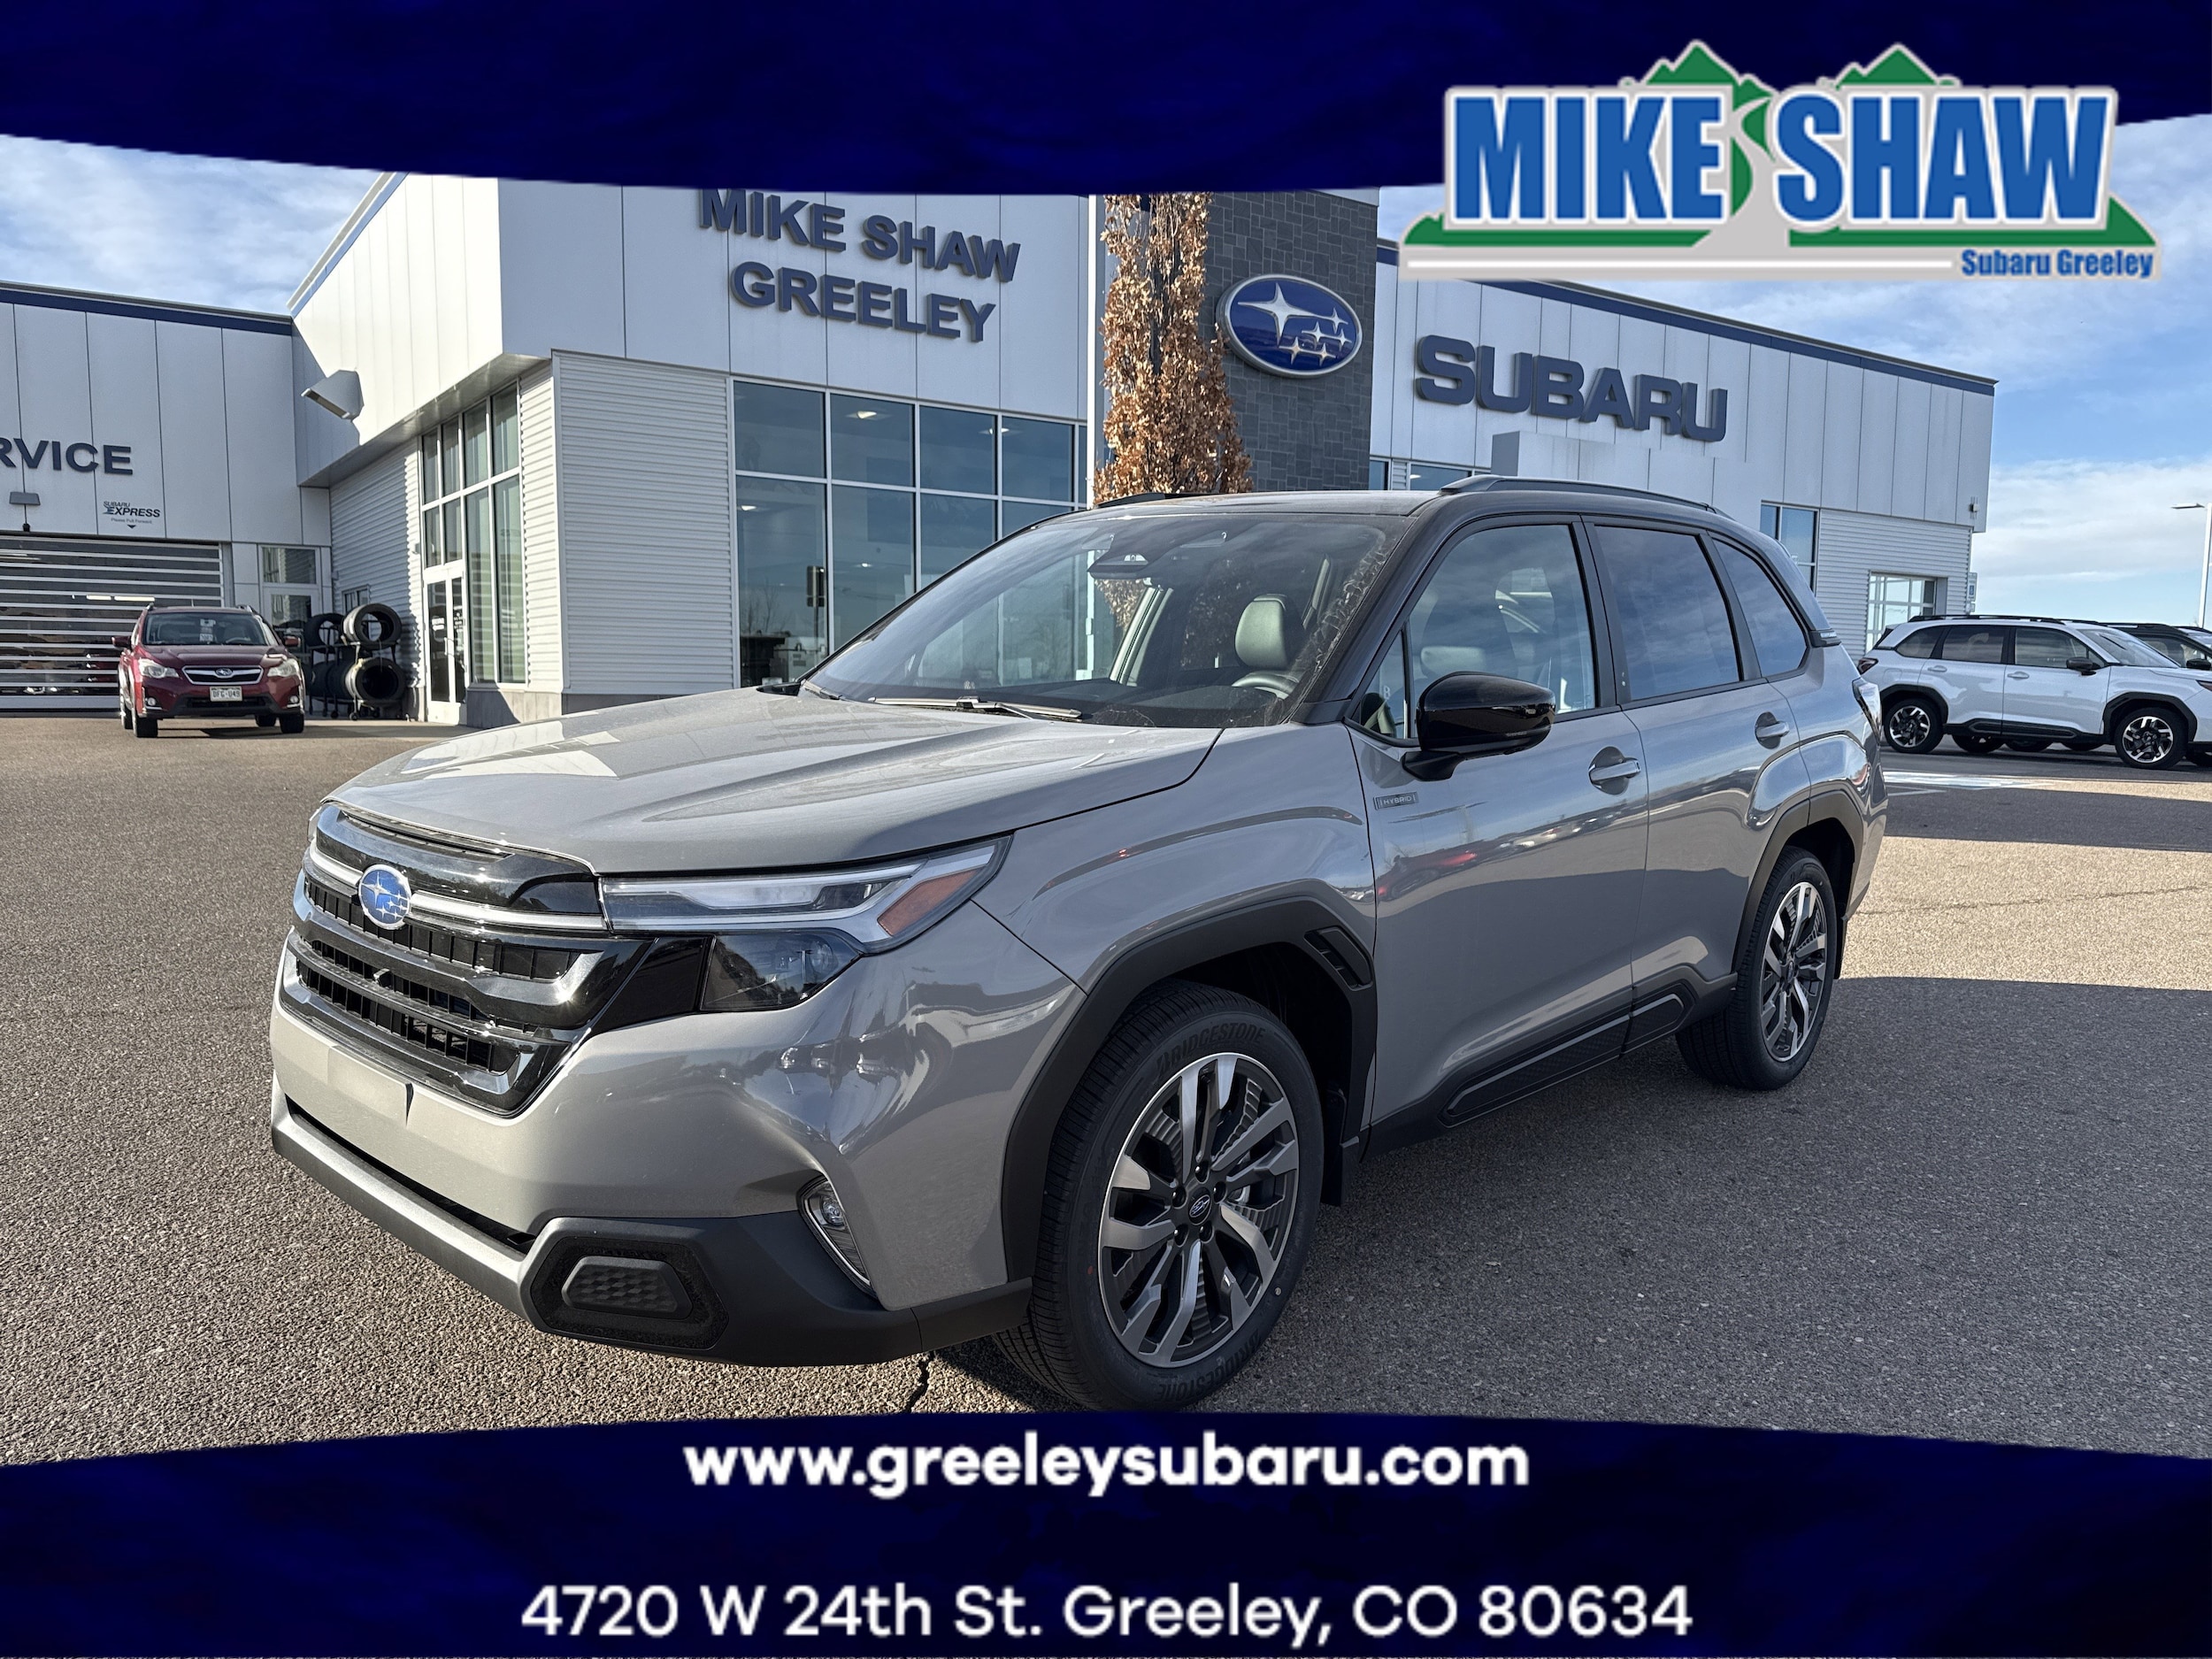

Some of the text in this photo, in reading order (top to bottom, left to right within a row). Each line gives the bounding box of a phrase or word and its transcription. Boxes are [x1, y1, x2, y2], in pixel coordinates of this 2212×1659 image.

[700, 187, 1021, 283] MIKE SHAW
[731, 260, 996, 342] GREELEY
[1414, 334, 1728, 442] SUBARU
[103, 506, 161, 518] EXPRESS
[1157, 1022, 1266, 1078] BRIDGESTONE
